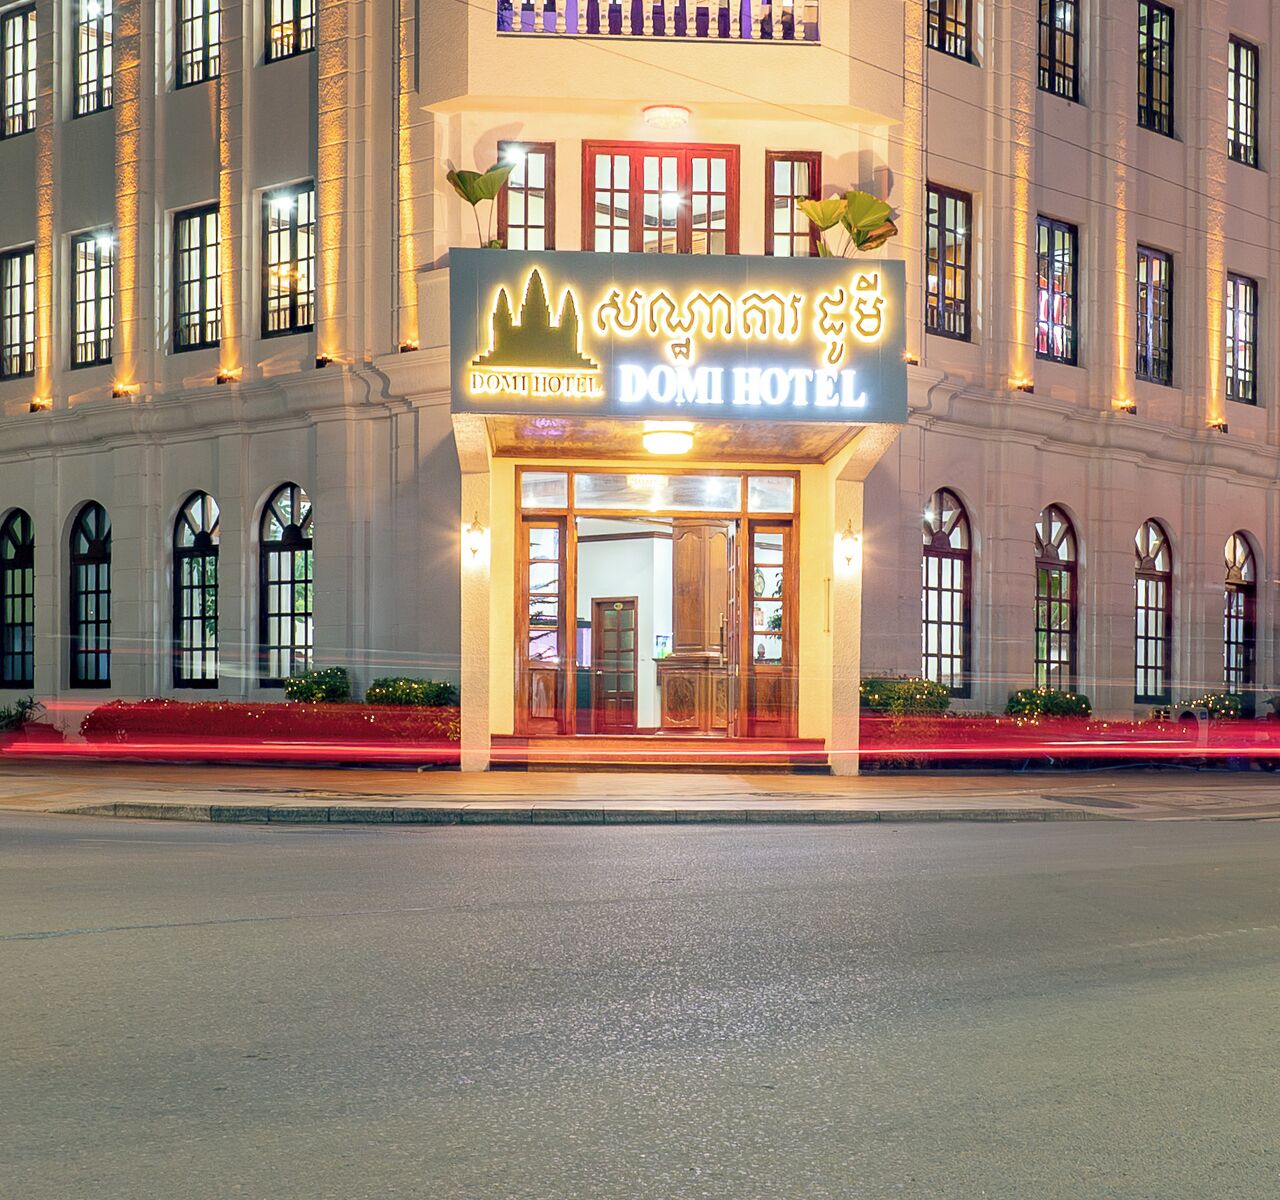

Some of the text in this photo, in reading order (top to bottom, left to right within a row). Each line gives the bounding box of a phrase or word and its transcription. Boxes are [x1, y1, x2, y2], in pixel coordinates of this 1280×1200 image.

[818, 273, 884, 364] ដូមី
[472, 373, 602, 393] DOMI HOTEL
[619, 365, 866, 408] DOMI HOTEL
